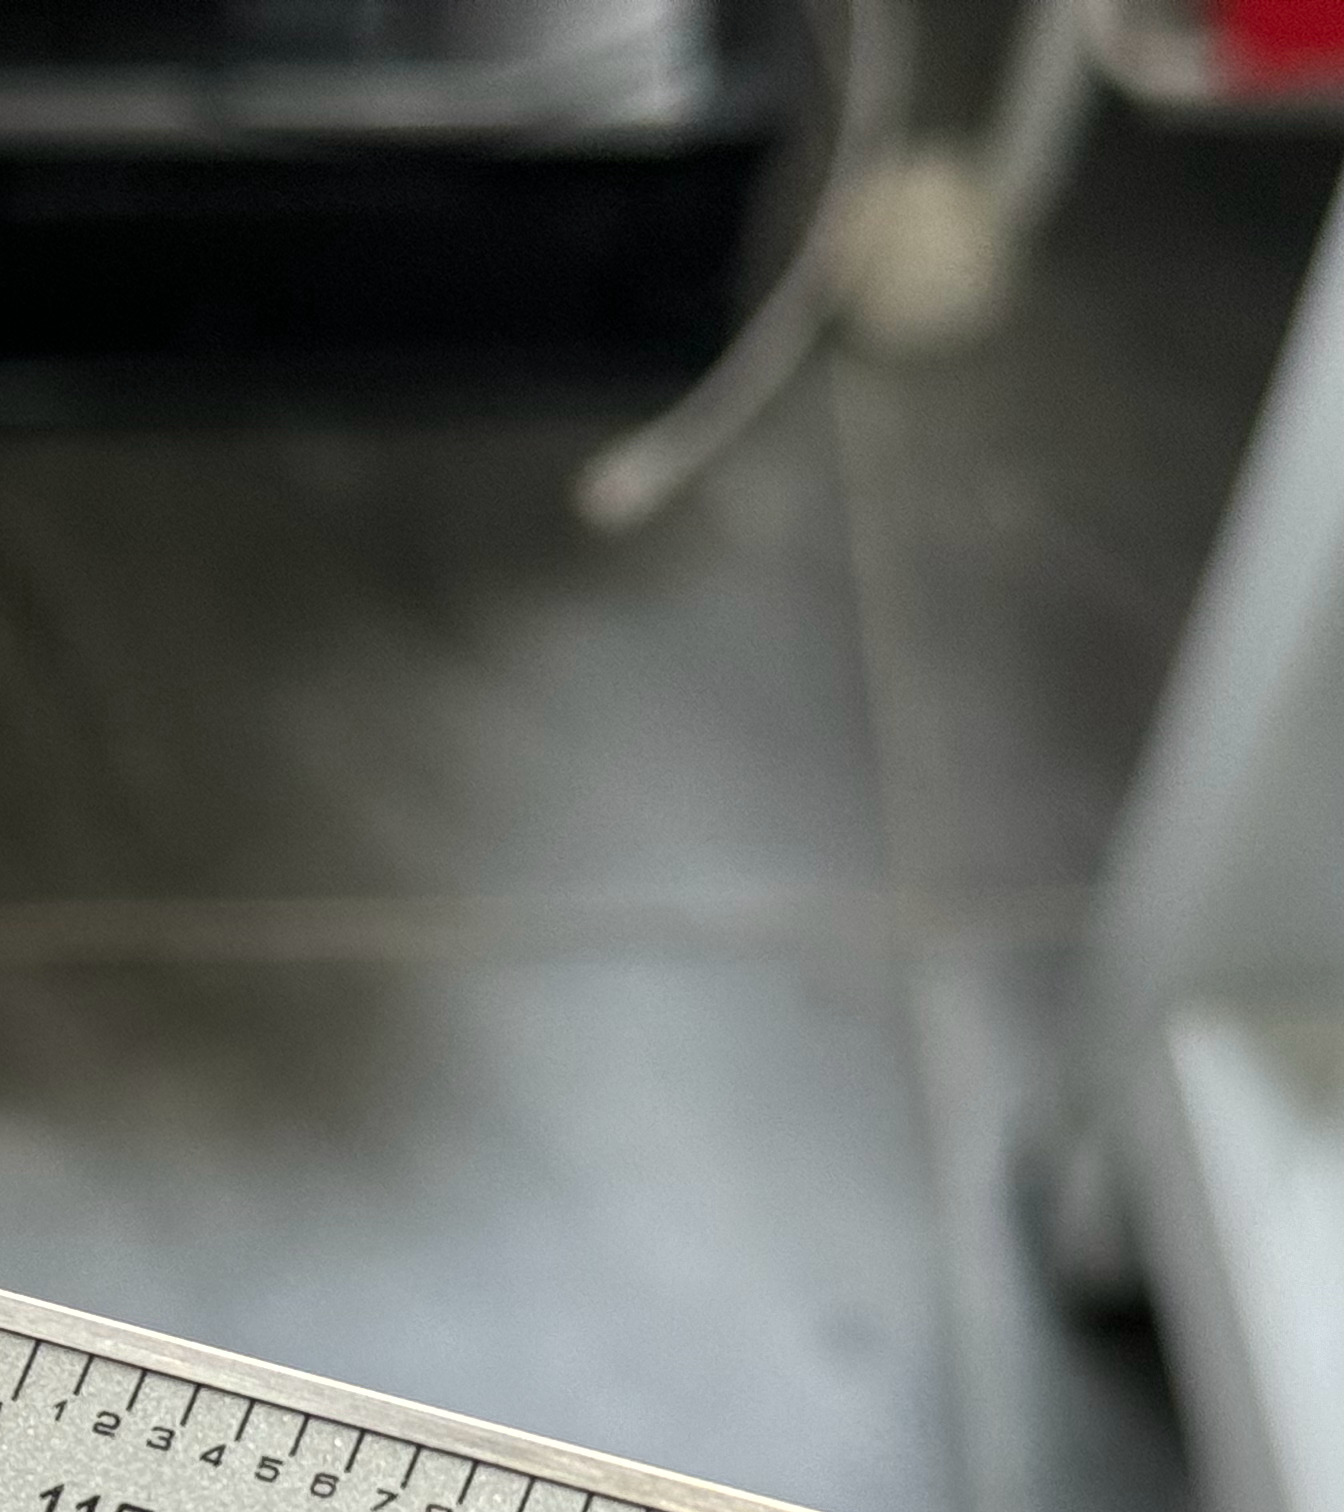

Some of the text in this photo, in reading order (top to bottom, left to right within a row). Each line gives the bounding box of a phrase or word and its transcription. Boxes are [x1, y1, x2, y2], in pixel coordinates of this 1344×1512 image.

[54, 1399, 68, 1422] 1
[92, 1410, 122, 1438] 2
[146, 1426, 176, 1452] 3
[199, 1444, 227, 1468] 4
[254, 1455, 284, 1484] 5
[309, 1472, 340, 1500] 6
[370, 1488, 399, 1512] 7
